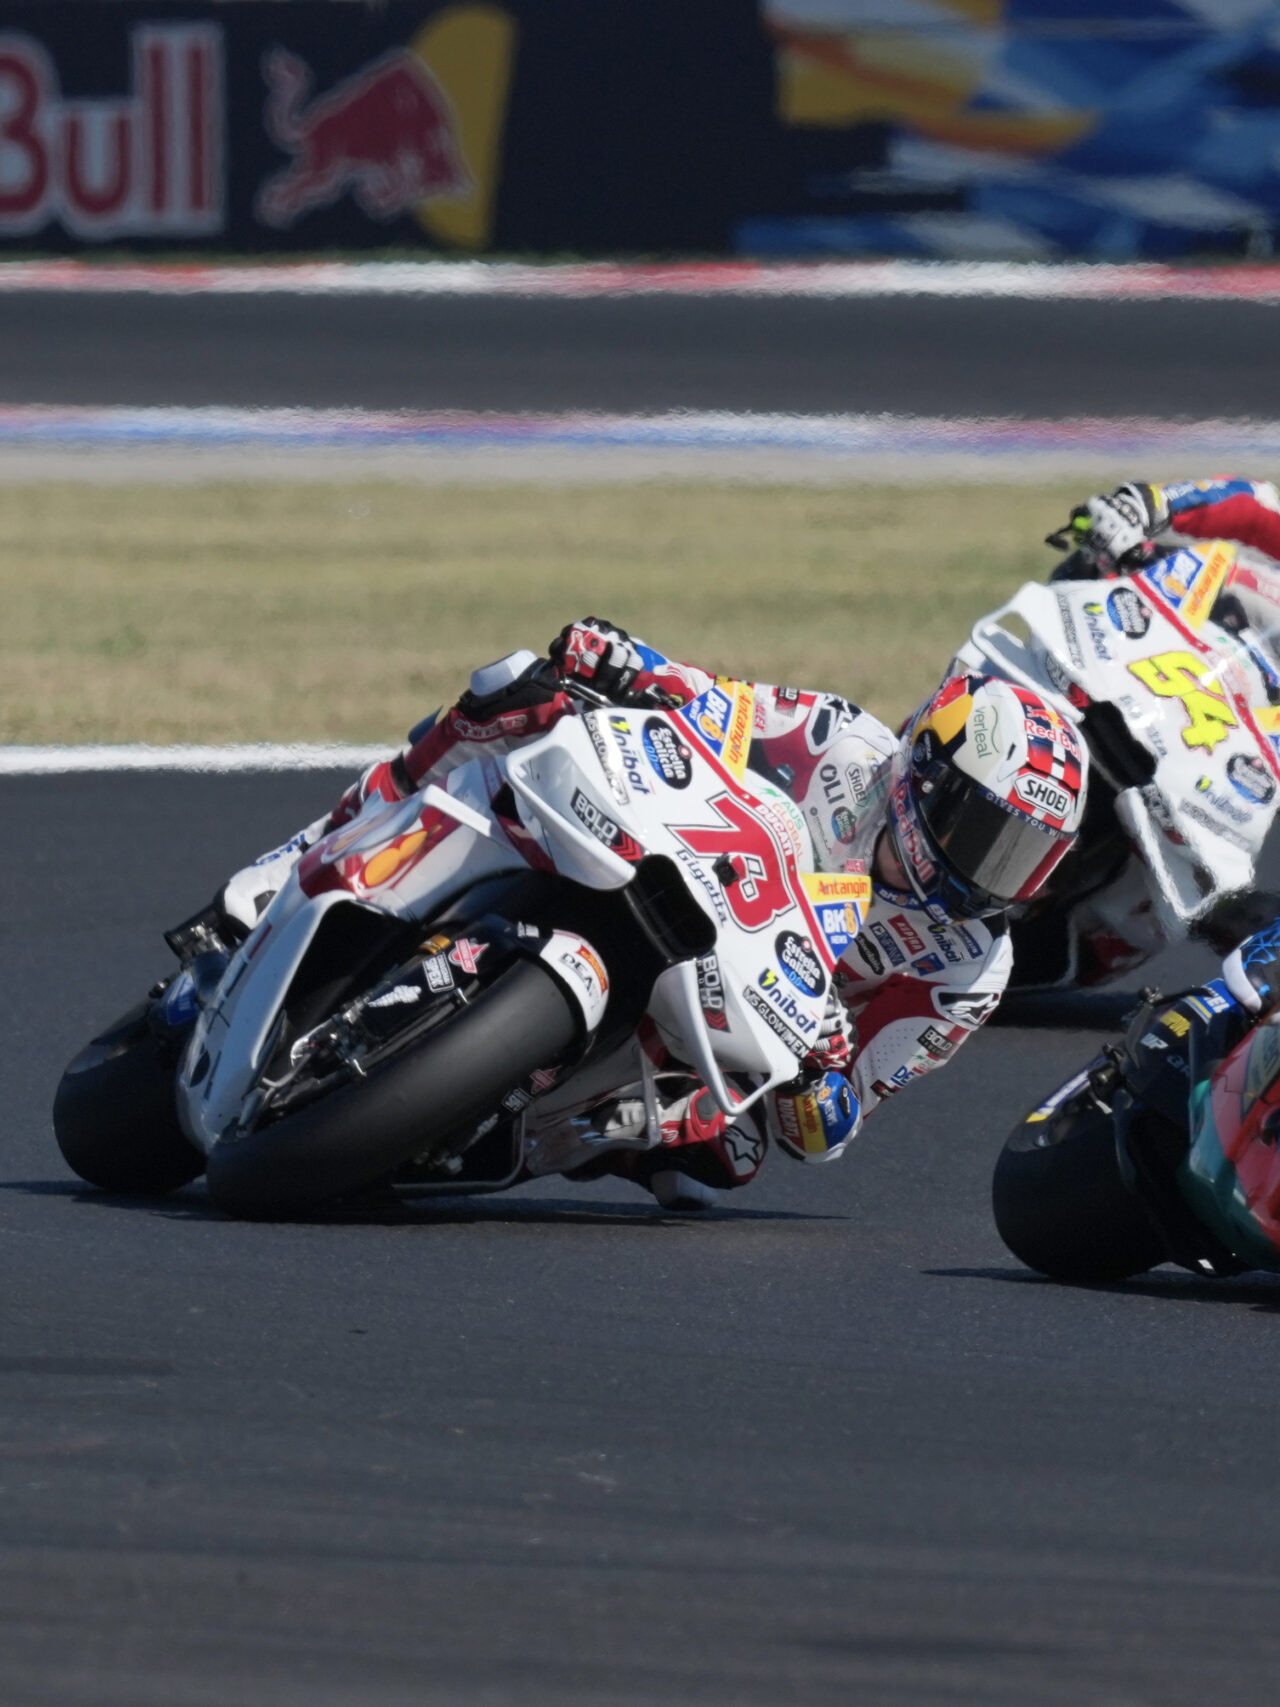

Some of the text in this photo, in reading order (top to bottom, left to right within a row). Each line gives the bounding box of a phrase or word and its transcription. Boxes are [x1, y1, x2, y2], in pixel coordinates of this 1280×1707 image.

[1126, 651, 1239, 756] 54
[649, 729, 674, 779] Galicia
[659, 727, 686, 780] Estrella
[729, 694, 751, 764] Antangin
[1024, 719, 1057, 742] Red
[608, 715, 651, 795] Unibat
[576, 793, 618, 839] BOLD
[782, 801, 804, 831] AUS
[986, 792, 1046, 831] GIVES YOU
[1024, 779, 1067, 813] SHOEI
[754, 804, 793, 856] DUCATI
[772, 802, 805, 860] GLOBAL
[893, 785, 936, 882] Red Bull
[663, 790, 797, 933] 73
[818, 878, 868, 896] Antangin
[822, 903, 856, 935] BK8
[927, 923, 962, 963] Unibat
[703, 955, 724, 1009] BOLD
[782, 950, 816, 989] Galicia
[784, 936, 822, 979] Estrella
[758, 967, 817, 1034] Unibat
